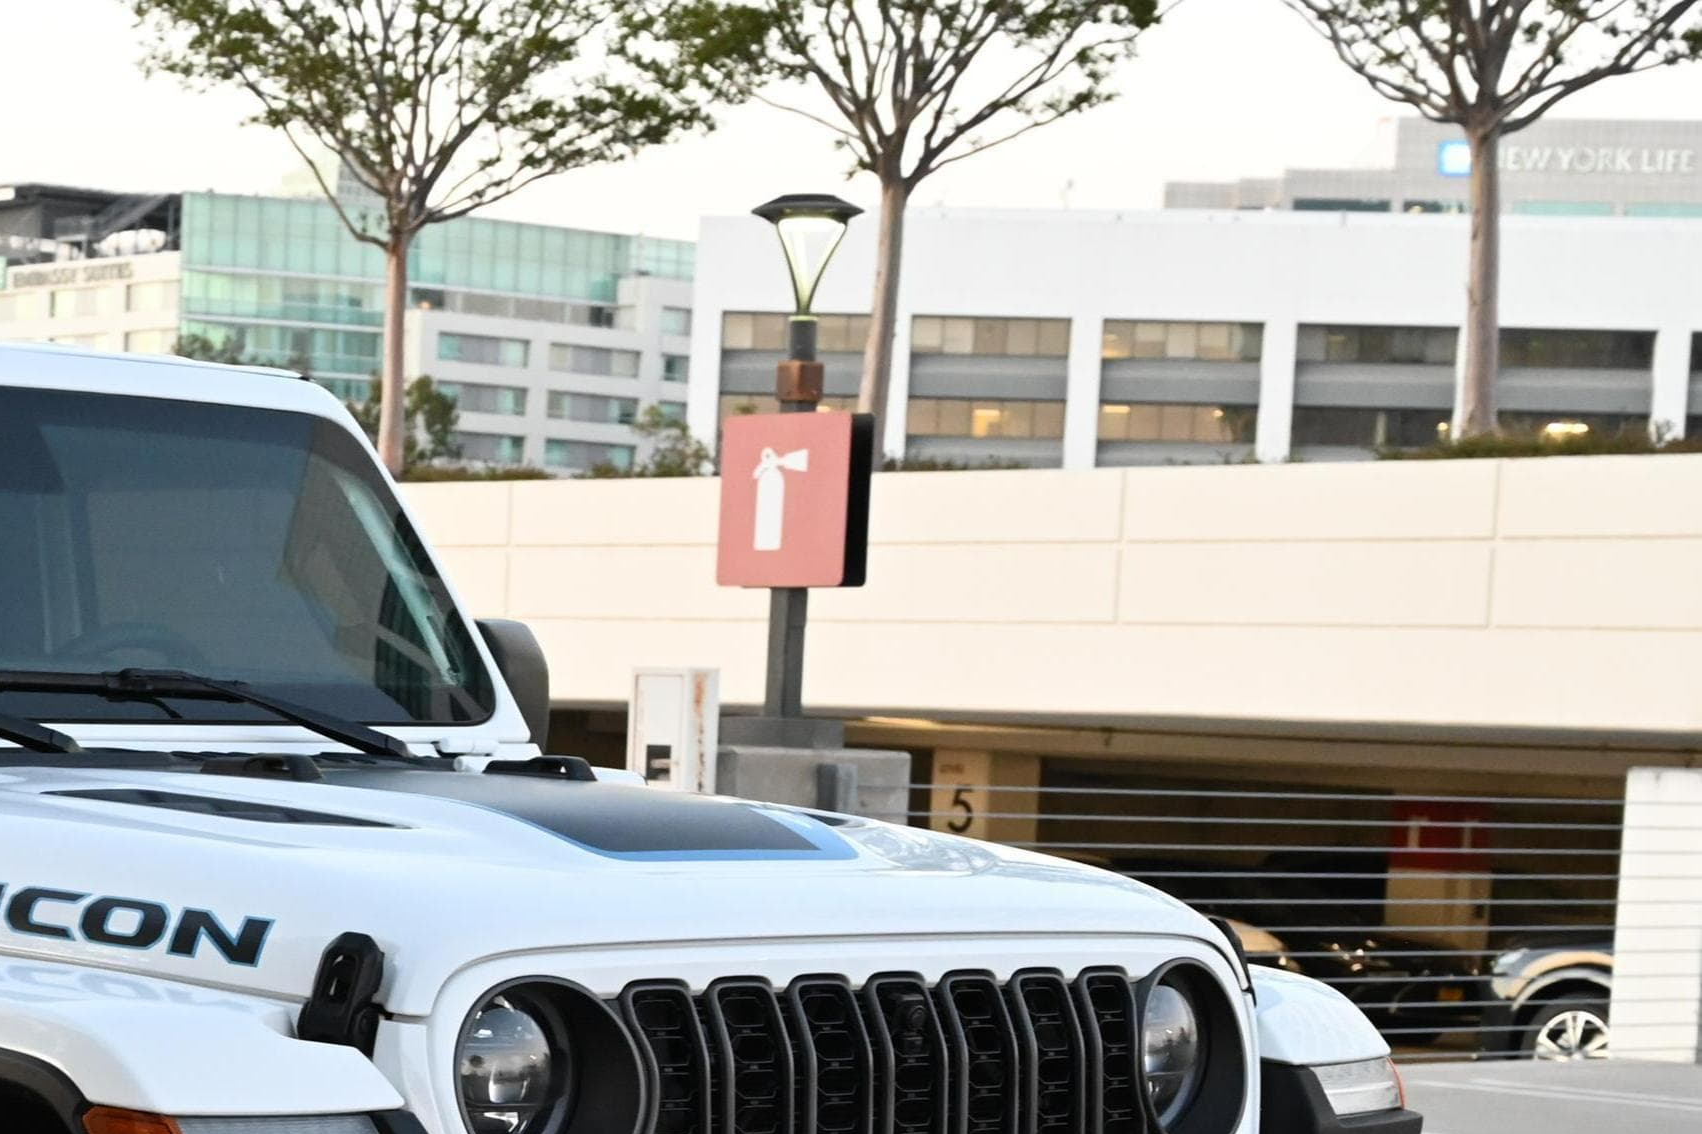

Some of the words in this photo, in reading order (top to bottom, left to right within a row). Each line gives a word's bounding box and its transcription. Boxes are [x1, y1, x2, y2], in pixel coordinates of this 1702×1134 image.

[1556, 146, 1634, 174] YORK
[1640, 147, 1695, 174] LIFE
[948, 784, 973, 833] 5
